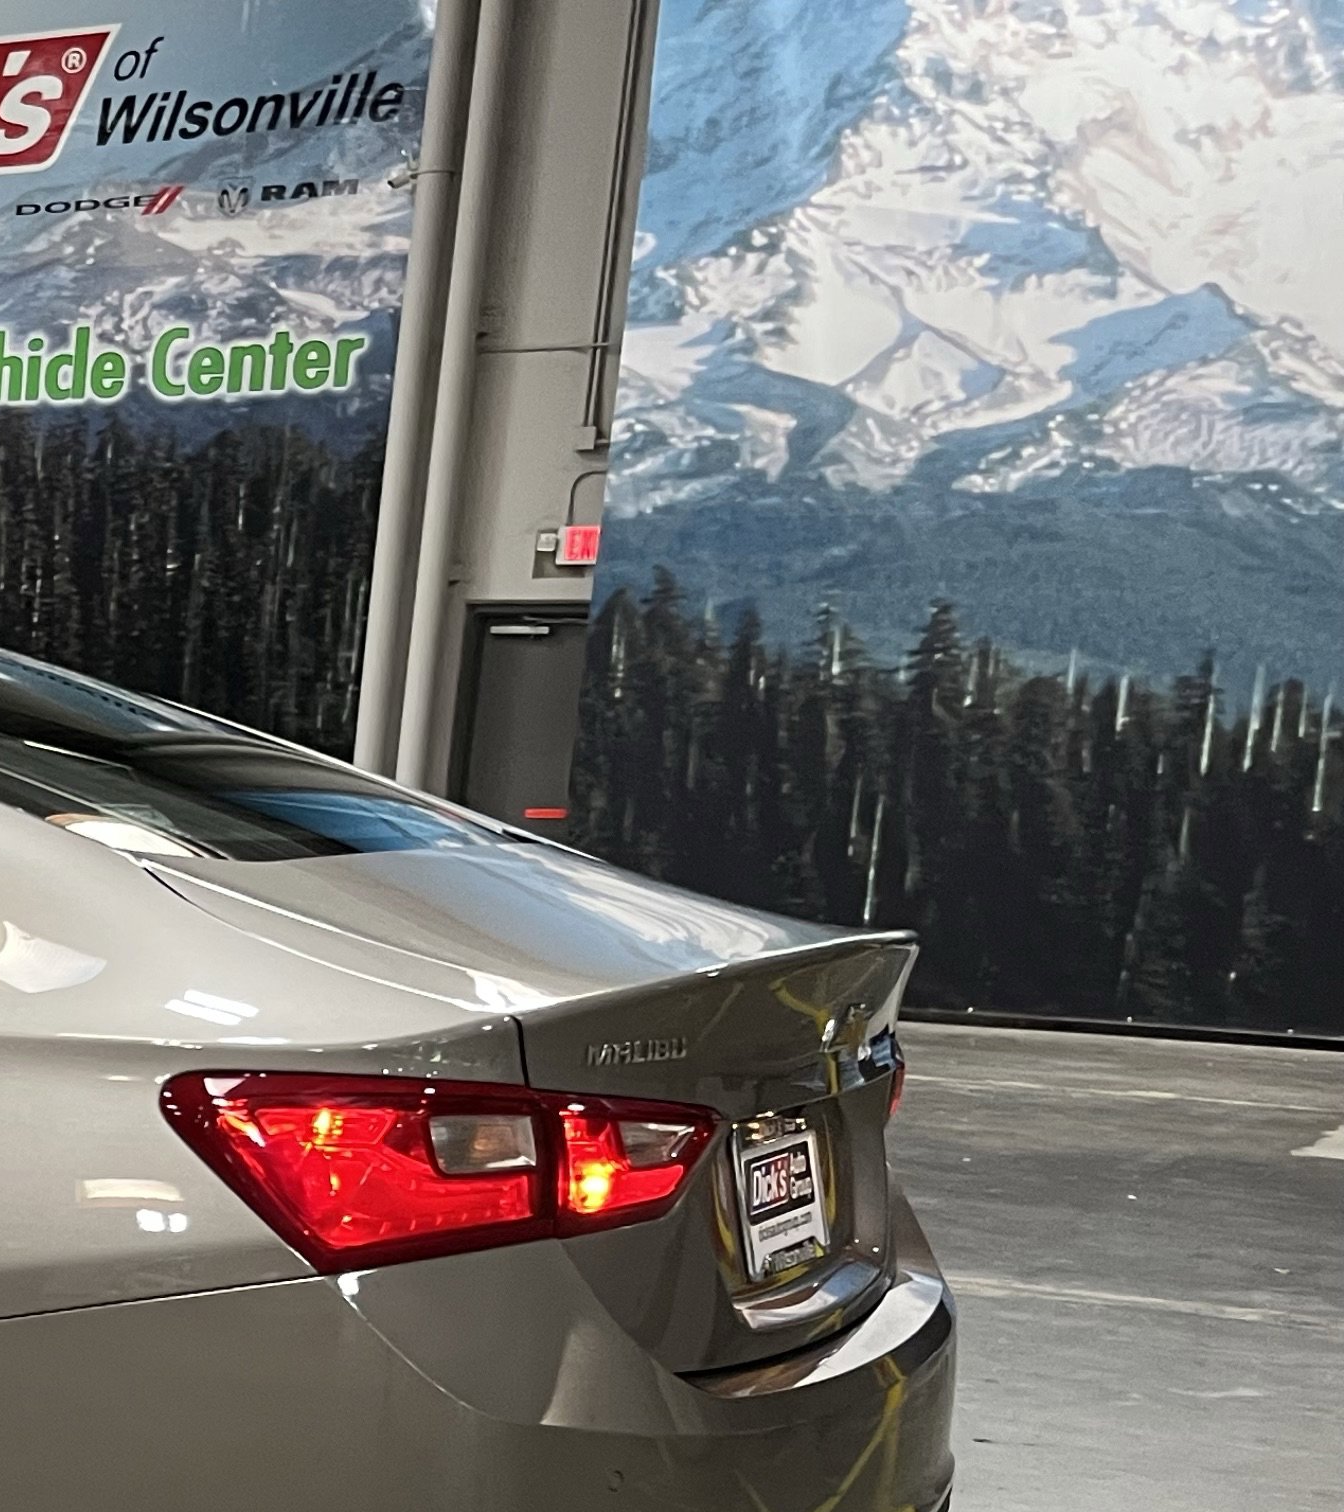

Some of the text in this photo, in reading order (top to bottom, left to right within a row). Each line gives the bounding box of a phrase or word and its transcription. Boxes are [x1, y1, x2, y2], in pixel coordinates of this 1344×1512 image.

[113, 37, 165, 83] of
[96, 70, 403, 147] Wilsonville
[16, 195, 158, 216] DODGE
[260, 180, 359, 202] RAM
[150, 327, 366, 397] Center
[588, 1037, 687, 1066] MALIBU
